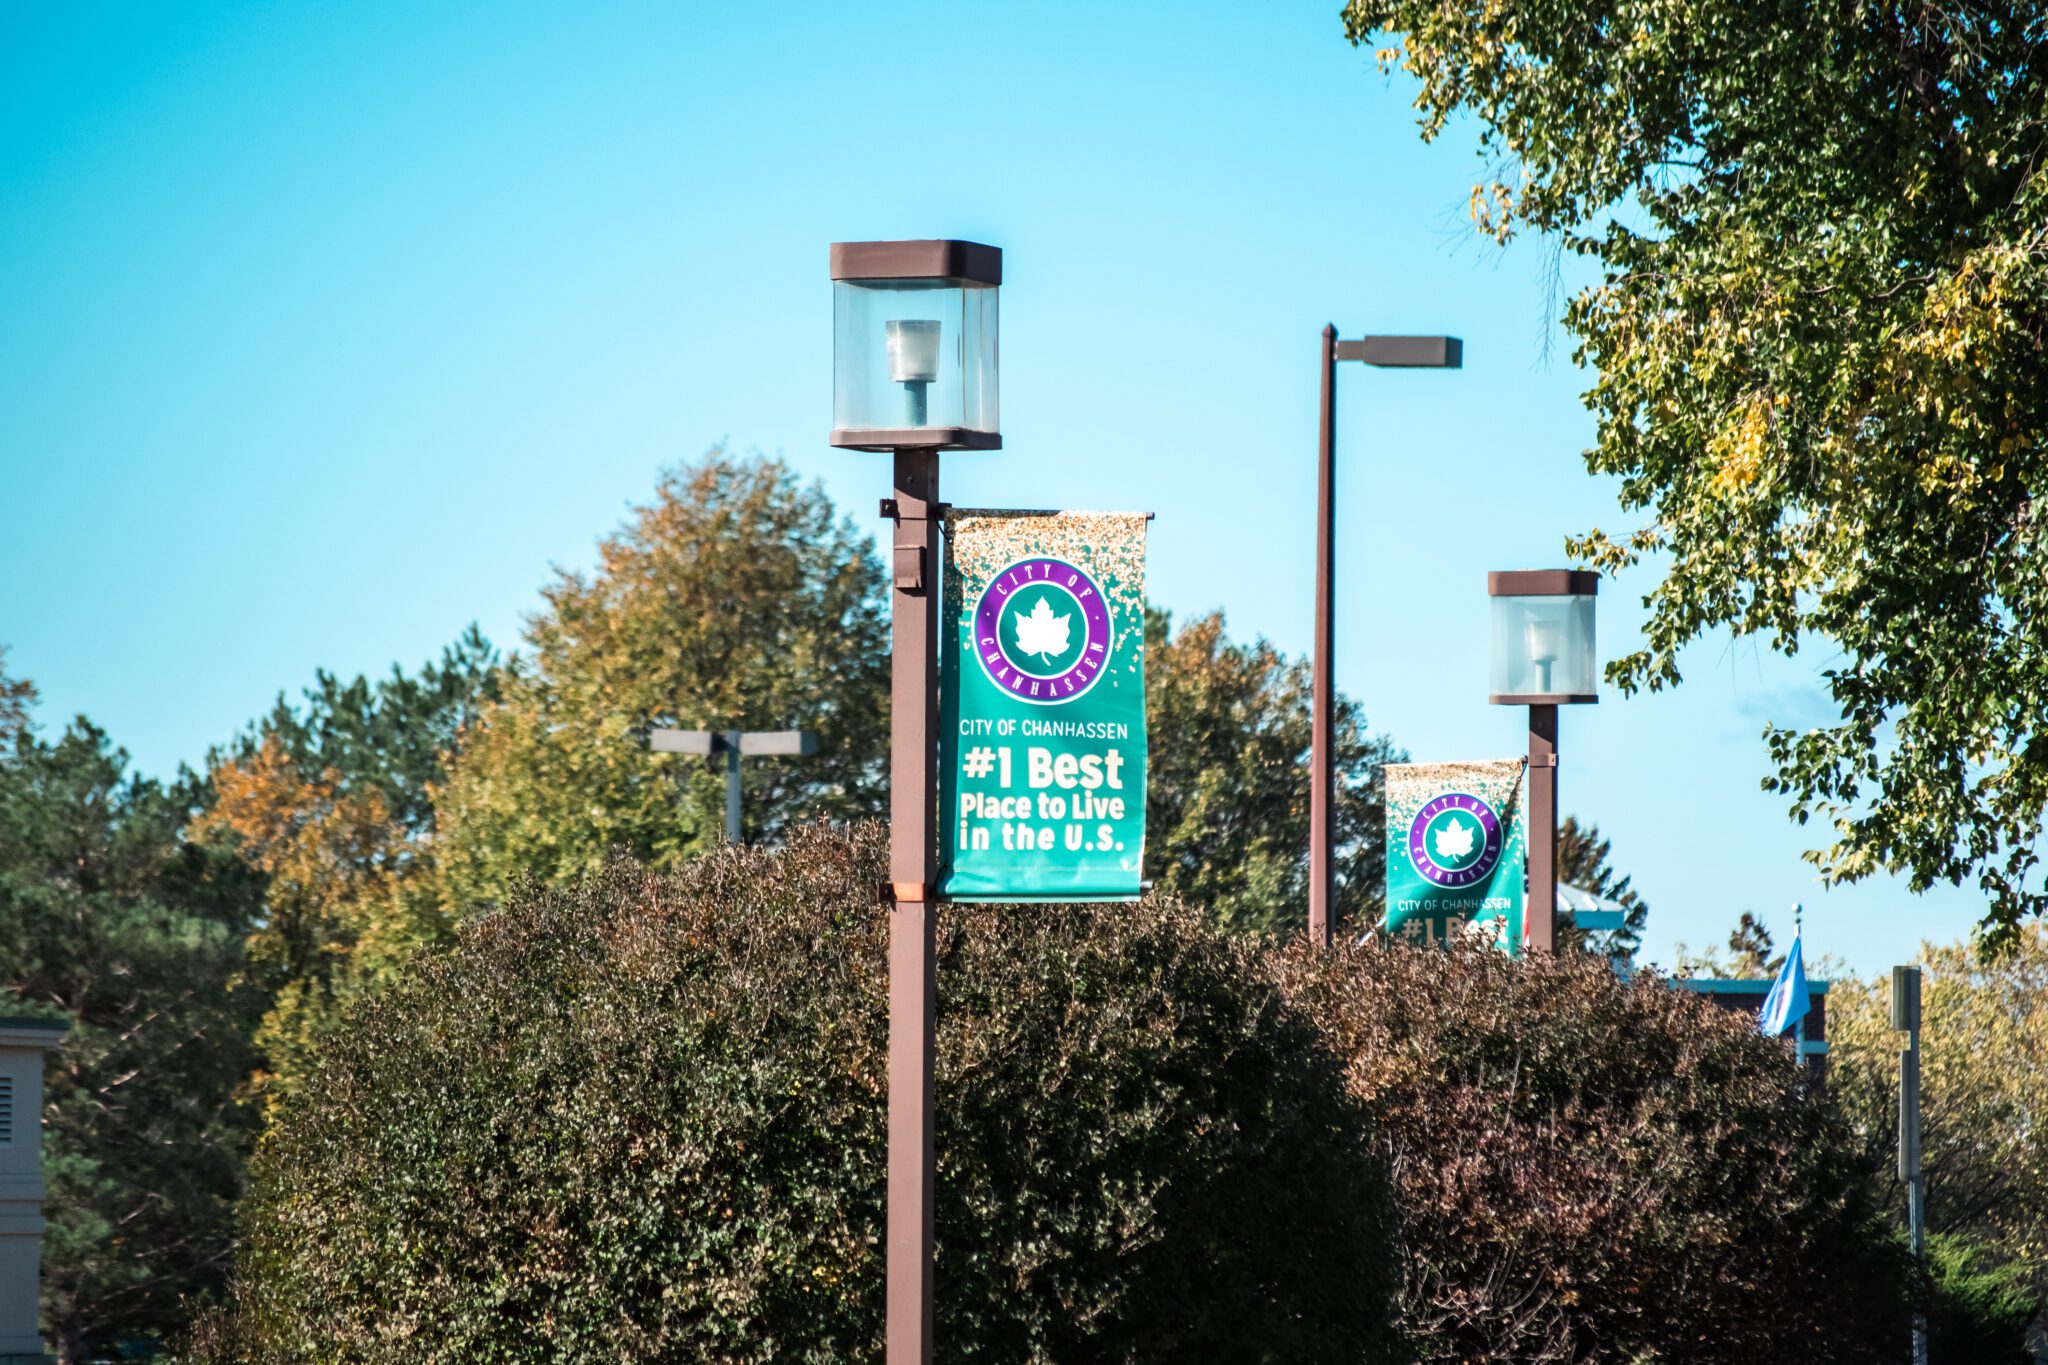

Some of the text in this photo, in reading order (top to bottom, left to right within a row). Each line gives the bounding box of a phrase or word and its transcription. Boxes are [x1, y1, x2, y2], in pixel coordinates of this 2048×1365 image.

[997, 564, 1093, 598] CITY OF
[981, 637, 1104, 697] CHANHASSEN
[959, 719, 1128, 739] CITY OF CHANHASSEN
[962, 747, 1124, 790] #1 Best
[960, 789, 1126, 820] Place to Live
[1422, 796, 1489, 820] CITY OF
[959, 820, 1124, 851] in the U.S.
[1414, 845, 1497, 883] CHANHASSEN
[1398, 898, 1511, 911] CITY OF CHANHASSEN
[1402, 917, 1435, 946] #1
